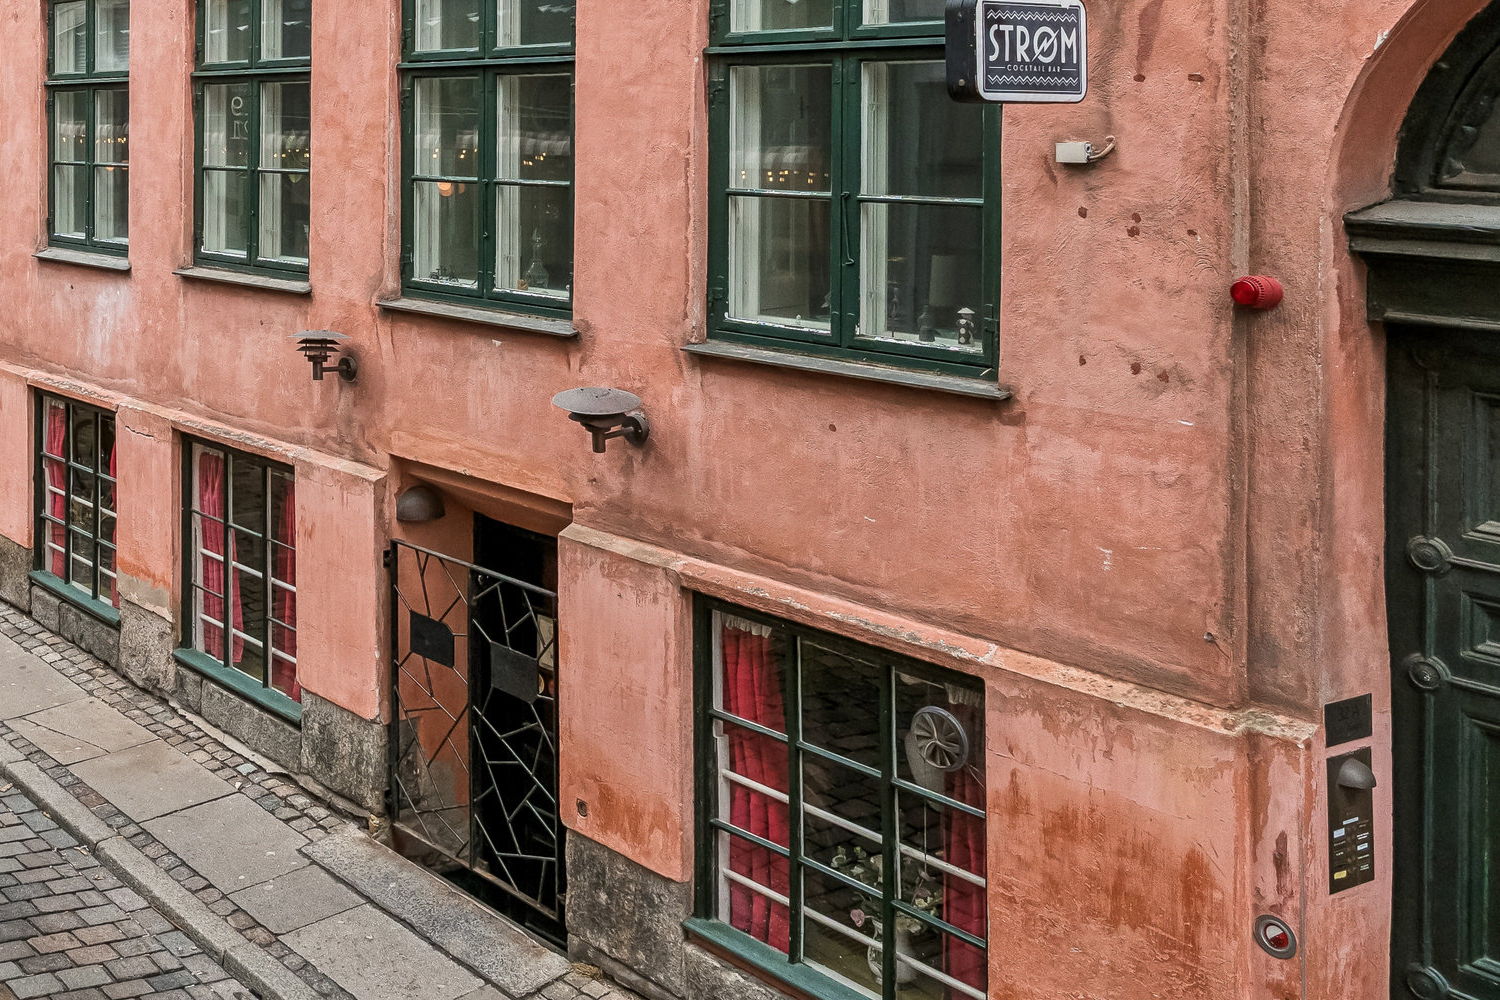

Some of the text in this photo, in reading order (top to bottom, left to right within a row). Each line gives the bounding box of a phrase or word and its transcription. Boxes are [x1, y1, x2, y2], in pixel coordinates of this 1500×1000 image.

[989, 24, 1077, 63] STRØM
[1007, 64, 1061, 73] COCKTAIL BAR
